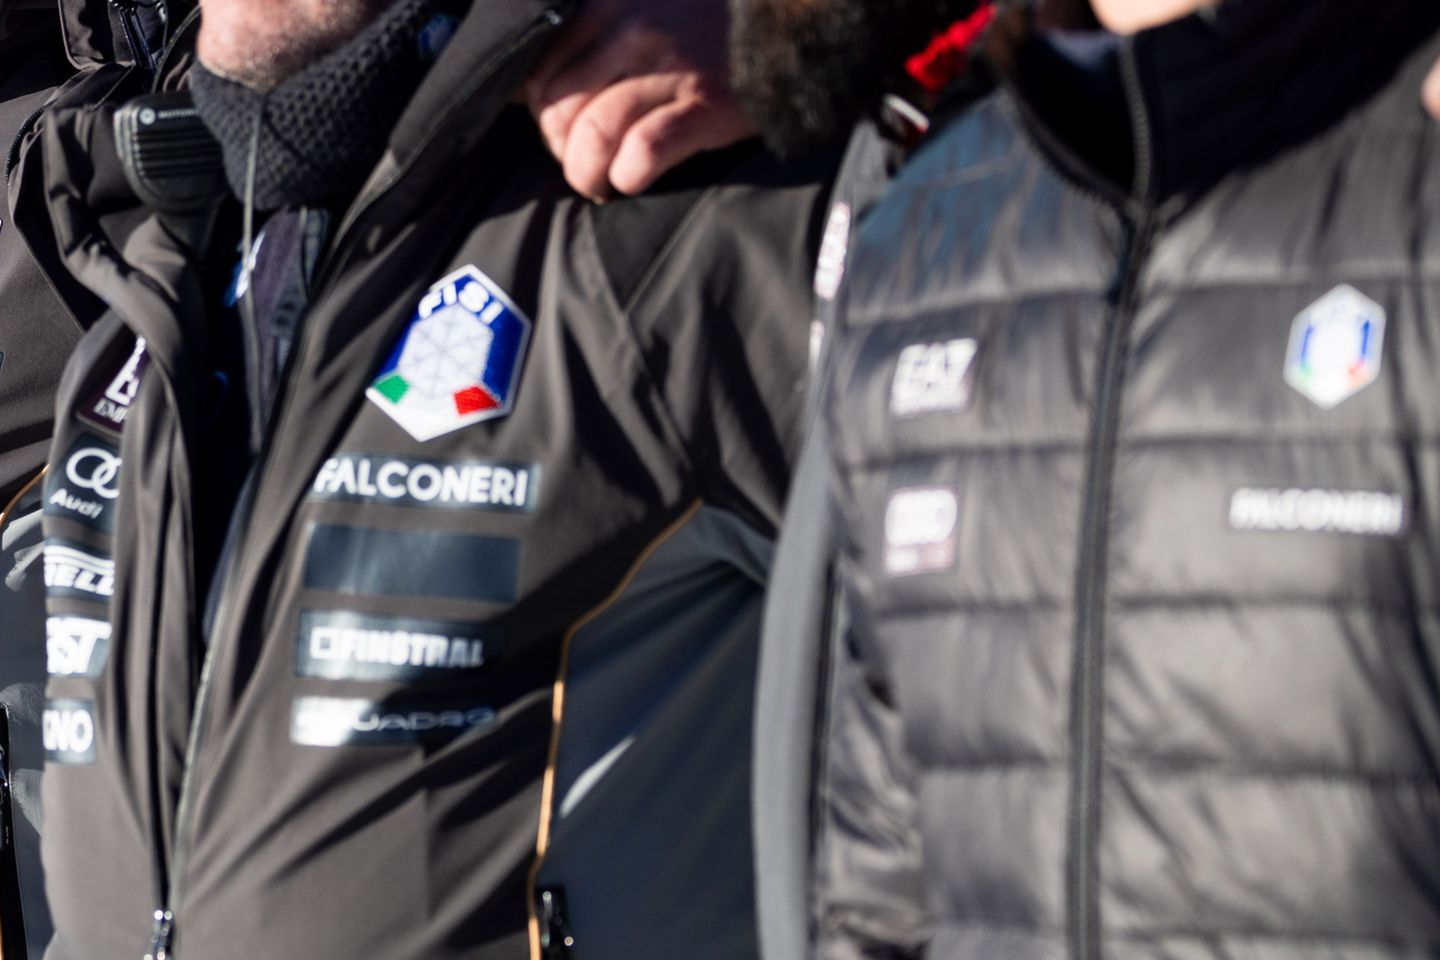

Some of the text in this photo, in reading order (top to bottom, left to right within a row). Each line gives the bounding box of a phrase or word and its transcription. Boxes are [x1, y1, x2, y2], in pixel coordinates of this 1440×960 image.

[418, 280, 505, 326] FISI
[48, 488, 104, 519] Audi
[313, 457, 528, 507] FALCONERI
